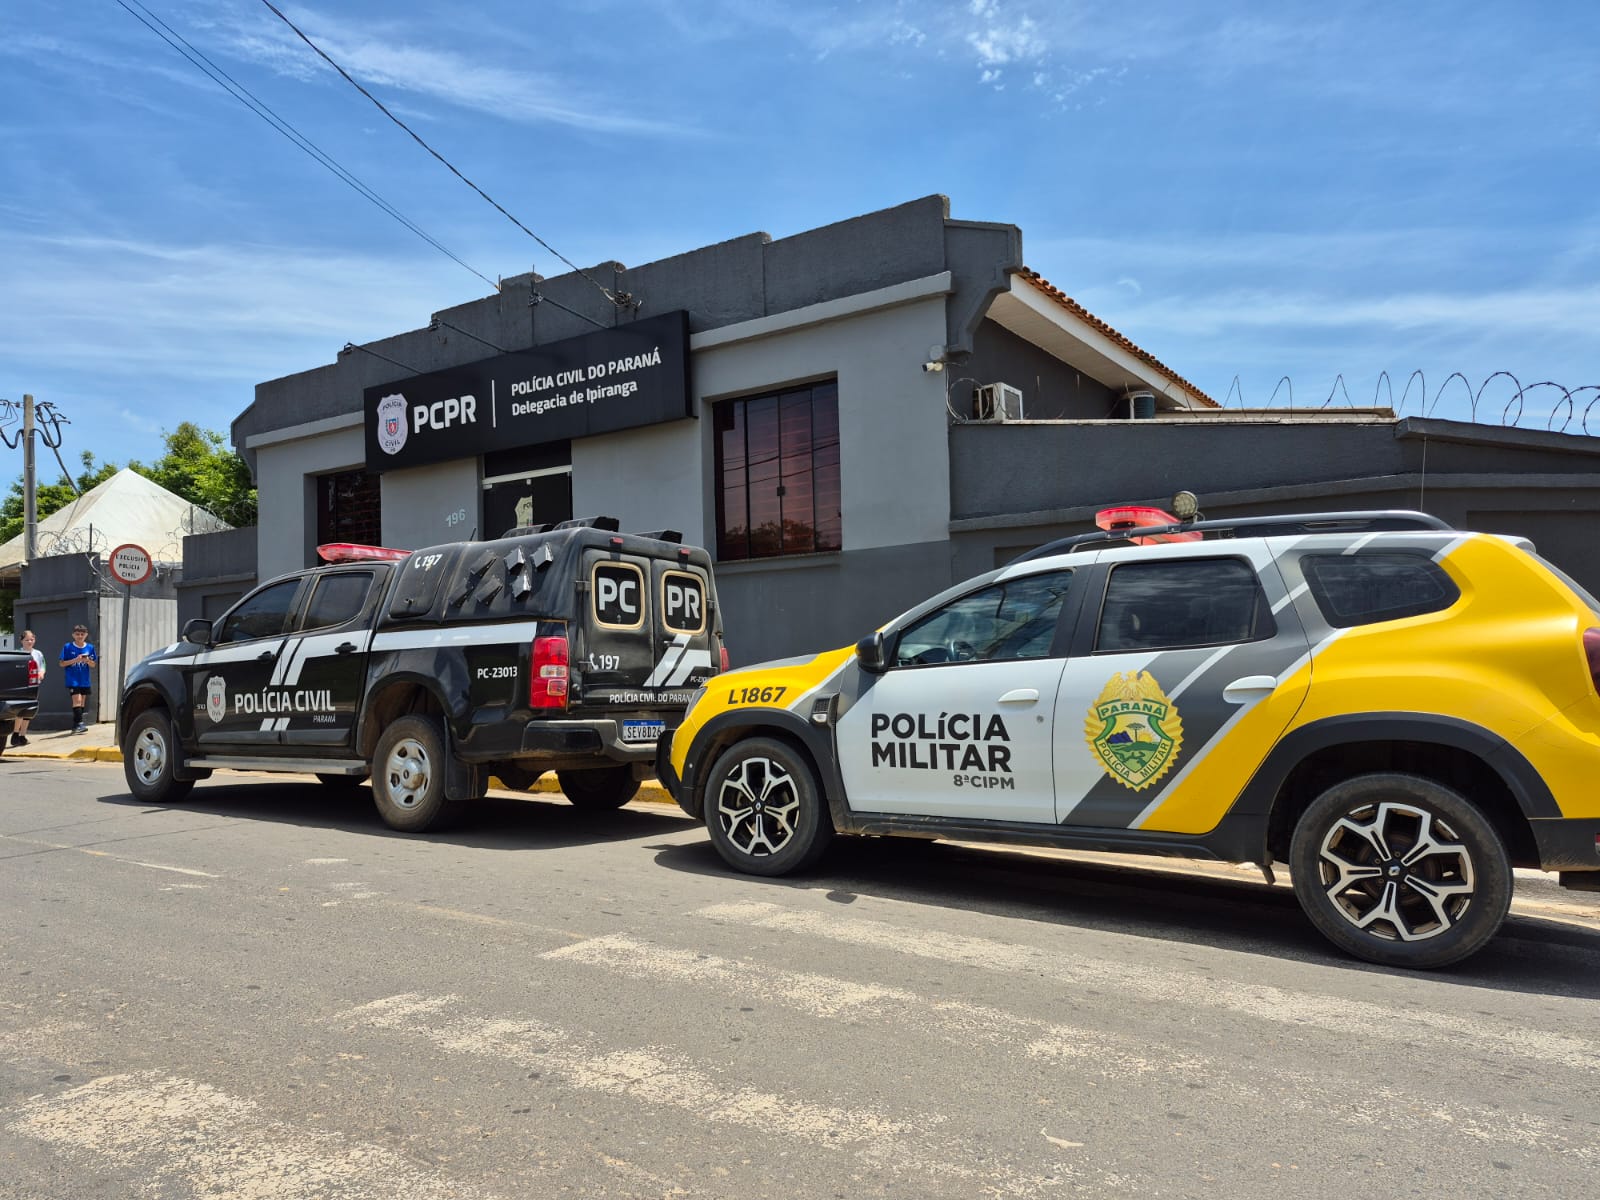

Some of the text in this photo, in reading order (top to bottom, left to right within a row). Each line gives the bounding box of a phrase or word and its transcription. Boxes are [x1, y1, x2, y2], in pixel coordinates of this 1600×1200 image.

[511, 347, 661, 397] POLÍCIA CIVIL DO PARANÁ
[512, 380, 638, 416] Delegacia de Ipiranga
[413, 395, 476, 434] PCPR
[445, 508, 466, 528] 196
[421, 553, 444, 567] 197
[598, 577, 701, 619] PC PR
[477, 666, 518, 680] PC-23013
[599, 655, 620, 671] 197
[235, 686, 336, 715] POLÍCIA CIVIL
[609, 691, 693, 703] POLÍCIA CIVIL DO PARAN
[728, 686, 787, 705] L1867
[312, 713, 336, 723] PARANÁ
[871, 741, 1012, 773] MILITAR
[1139, 742, 1170, 778] MILITAR
